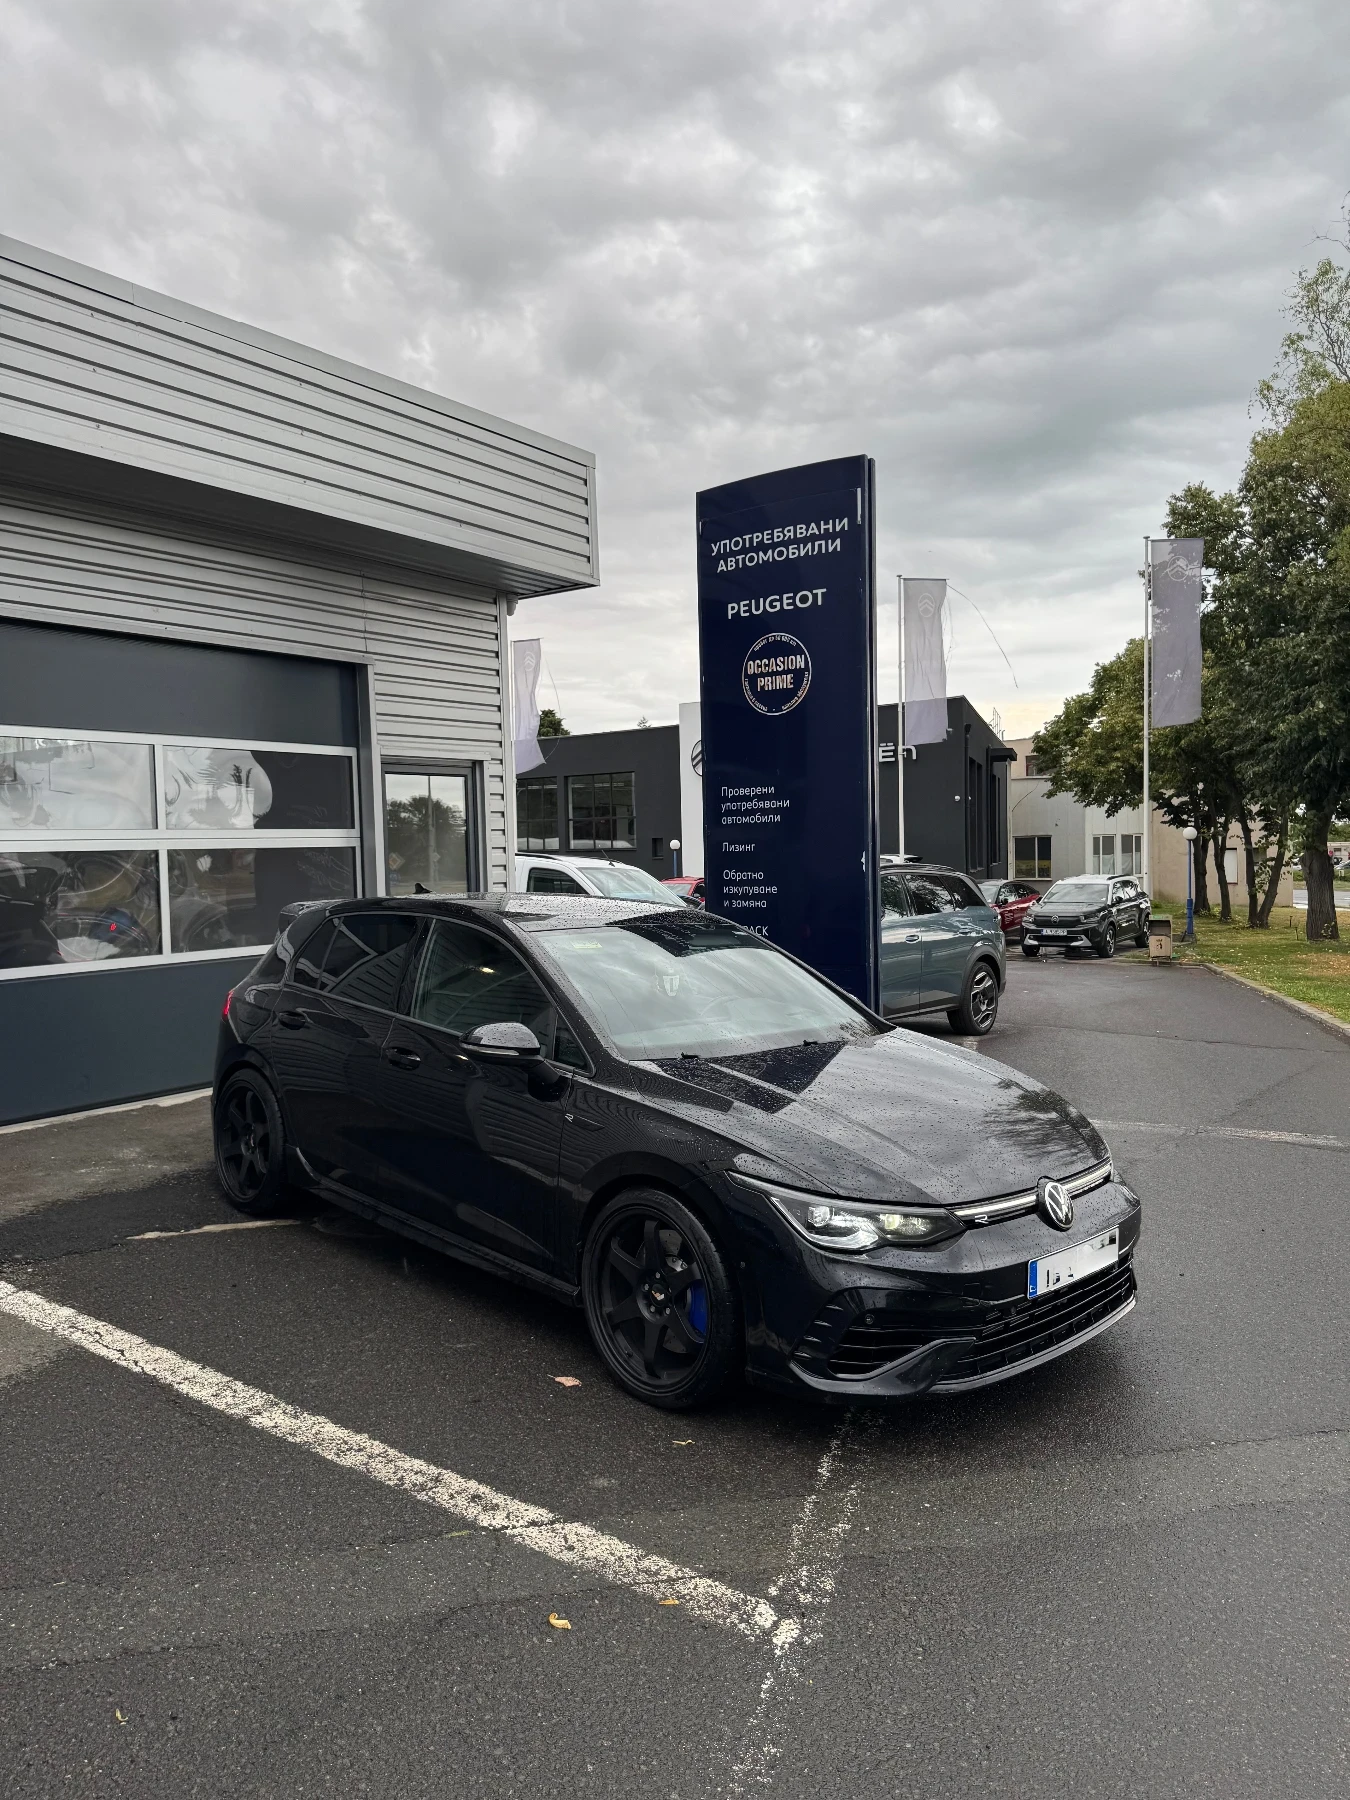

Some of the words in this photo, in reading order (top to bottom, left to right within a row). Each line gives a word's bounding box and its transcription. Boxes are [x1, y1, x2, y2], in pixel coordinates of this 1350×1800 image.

[711, 517, 849, 556] УПОТРЕБЯВАНИ
[716, 538, 842, 573] АВТОМОБИЛИ
[727, 588, 827, 619] PEUGEOT
[747, 654, 805, 675] OCCASION
[757, 673, 794, 692] PRIME
[721, 785, 775, 798] Проверени
[721, 799, 790, 812] употребявани
[721, 813, 781, 825] автомобили
[722, 842, 756, 852] Лизинг
[723, 869, 764, 881] Обратно
[723, 886, 778, 896] изкупуване
[723, 900, 730, 908] и
[731, 899, 767, 908] замяна
